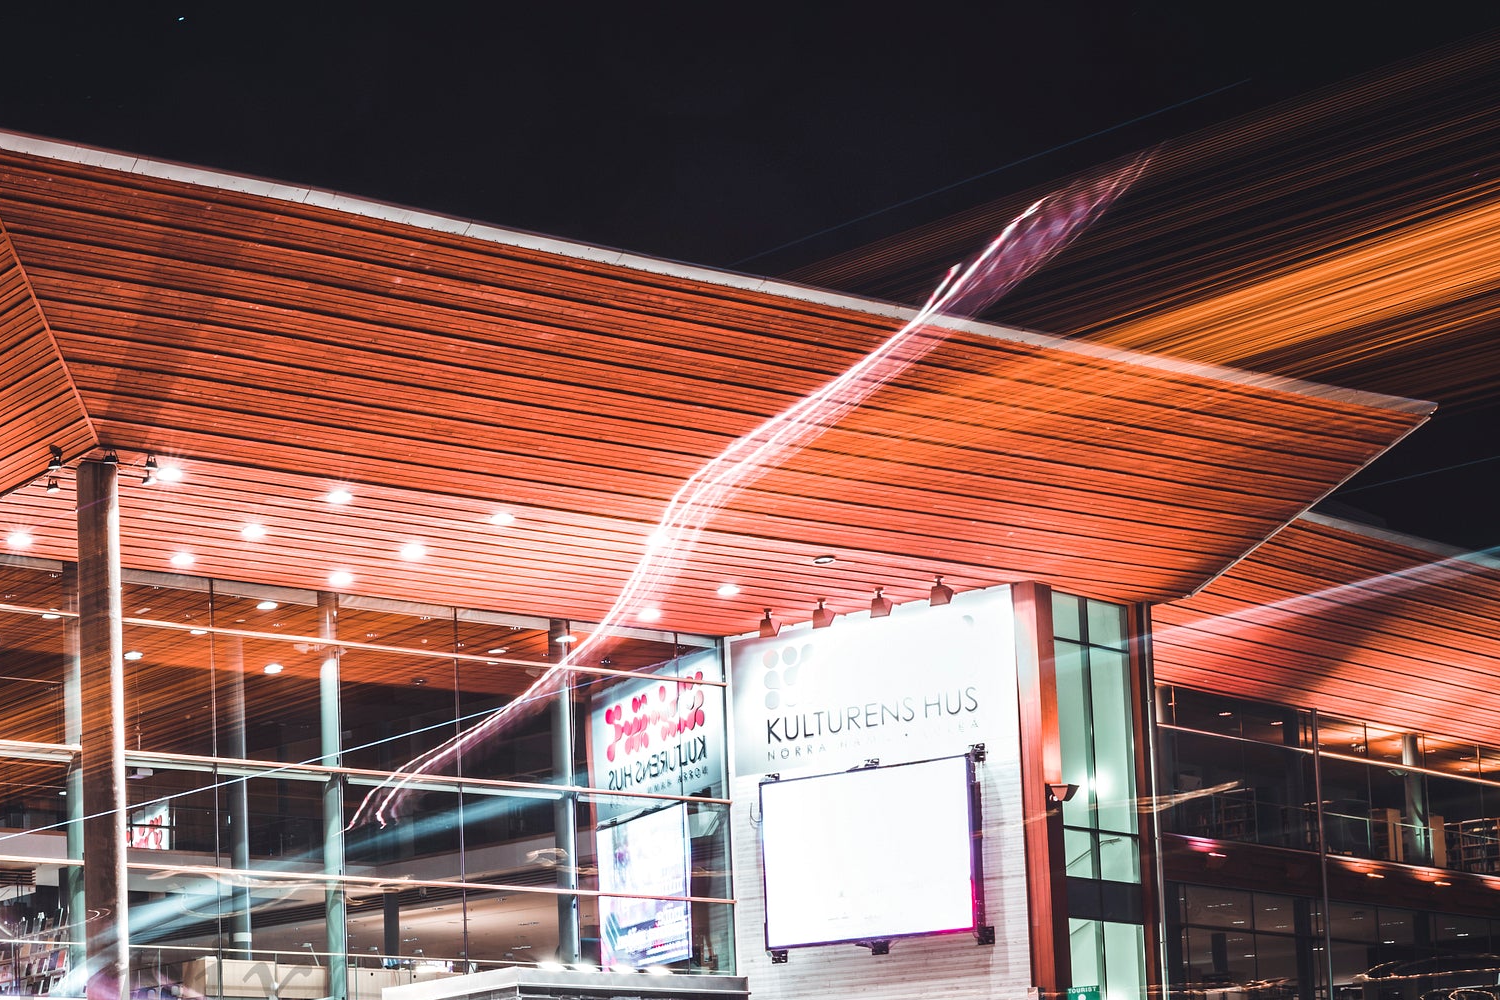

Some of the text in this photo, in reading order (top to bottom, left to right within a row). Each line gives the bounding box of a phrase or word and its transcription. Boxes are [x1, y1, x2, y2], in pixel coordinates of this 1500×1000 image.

[766, 686, 979, 745] KULTURENS HUS
[767, 745, 826, 762] NORRA
[838, 733, 892, 749] HAM
[1067, 986, 1097, 994] TOURIST
